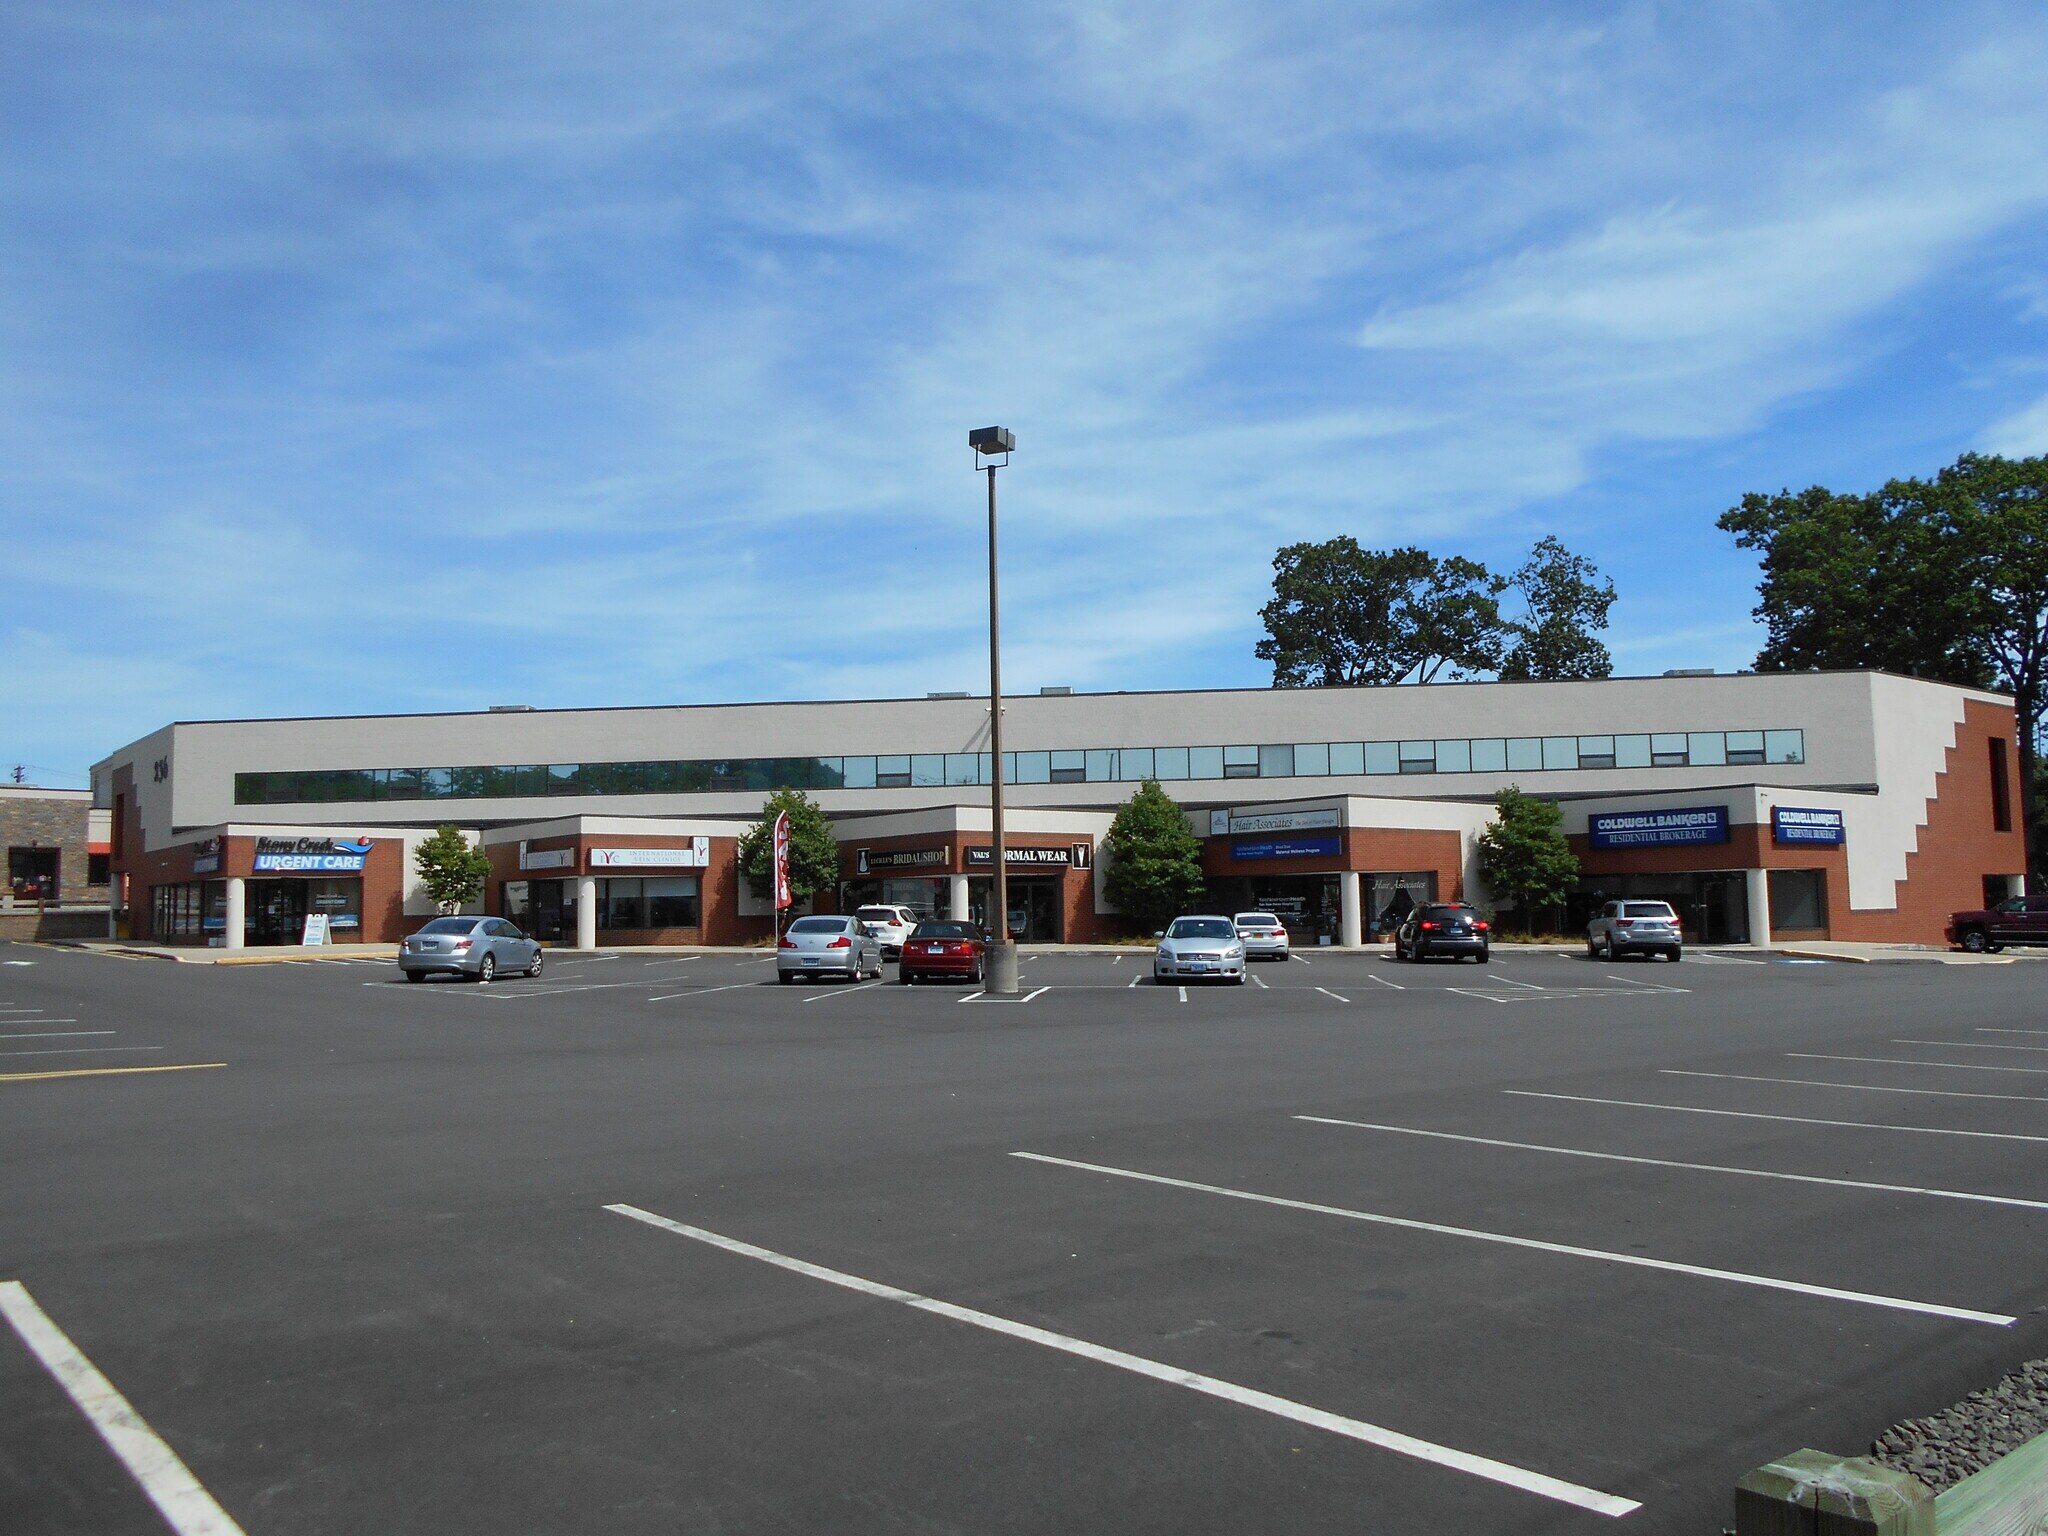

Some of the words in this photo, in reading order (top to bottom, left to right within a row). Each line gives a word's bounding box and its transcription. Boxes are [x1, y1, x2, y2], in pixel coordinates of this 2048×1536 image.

[1233, 819, 1252, 831] Hair
[1253, 817, 1293, 830] Associates
[1597, 817, 1656, 830] COLDWELL
[1657, 813, 1708, 827] BANKER
[1609, 833, 1659, 843] RESIDENTIAL
[1660, 829, 1707, 841] BROKERAGE
[256, 837, 297, 855] Stony
[297, 837, 335, 853] Creek
[259, 856, 322, 869] URGENT
[324, 856, 362, 869] CARE
[893, 852, 923, 865] BRIDAL
[923, 850, 946, 862] SHOP
[972, 851, 990, 859] VAL'S
[1037, 851, 1068, 861] WEAR
[1371, 879, 1390, 890] Hair
